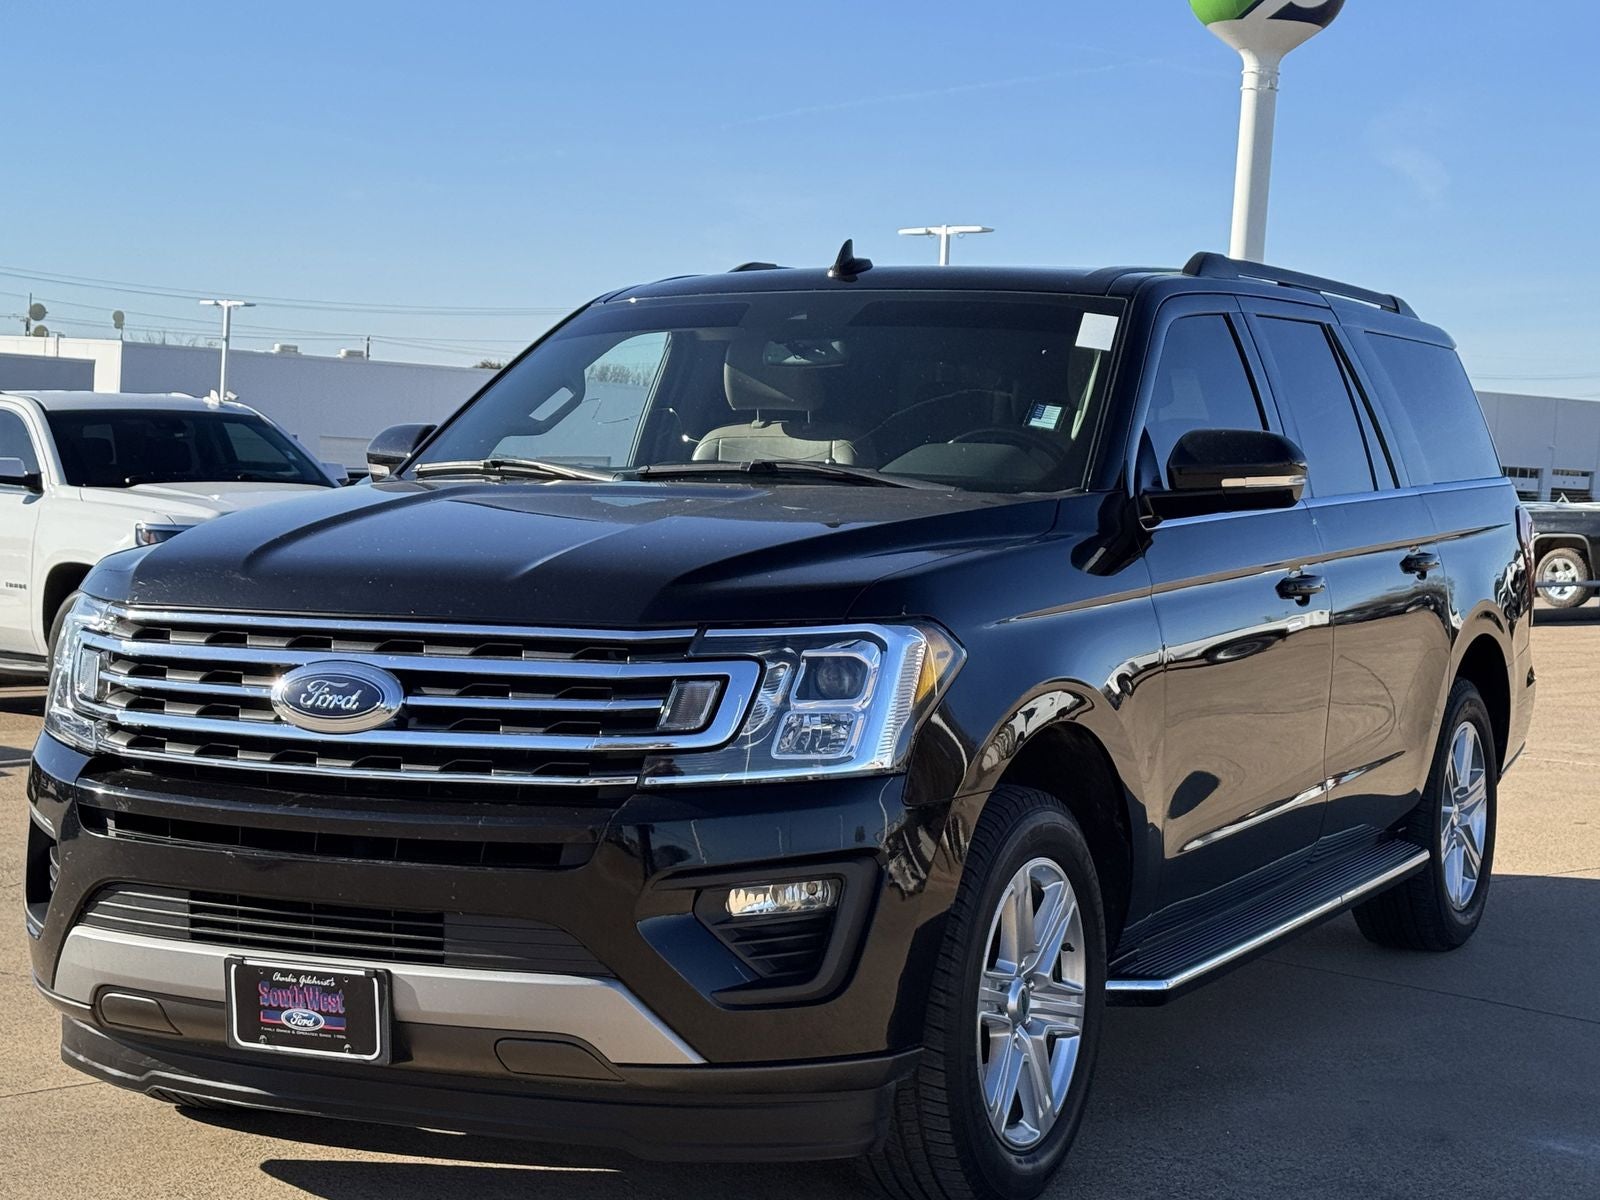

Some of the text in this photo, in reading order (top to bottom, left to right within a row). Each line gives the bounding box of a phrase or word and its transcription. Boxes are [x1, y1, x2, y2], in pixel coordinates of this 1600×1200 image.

[300, 680, 362, 710] Ford
[272, 971, 297, 982] Charlie
[290, 1012, 315, 1027] Ford
